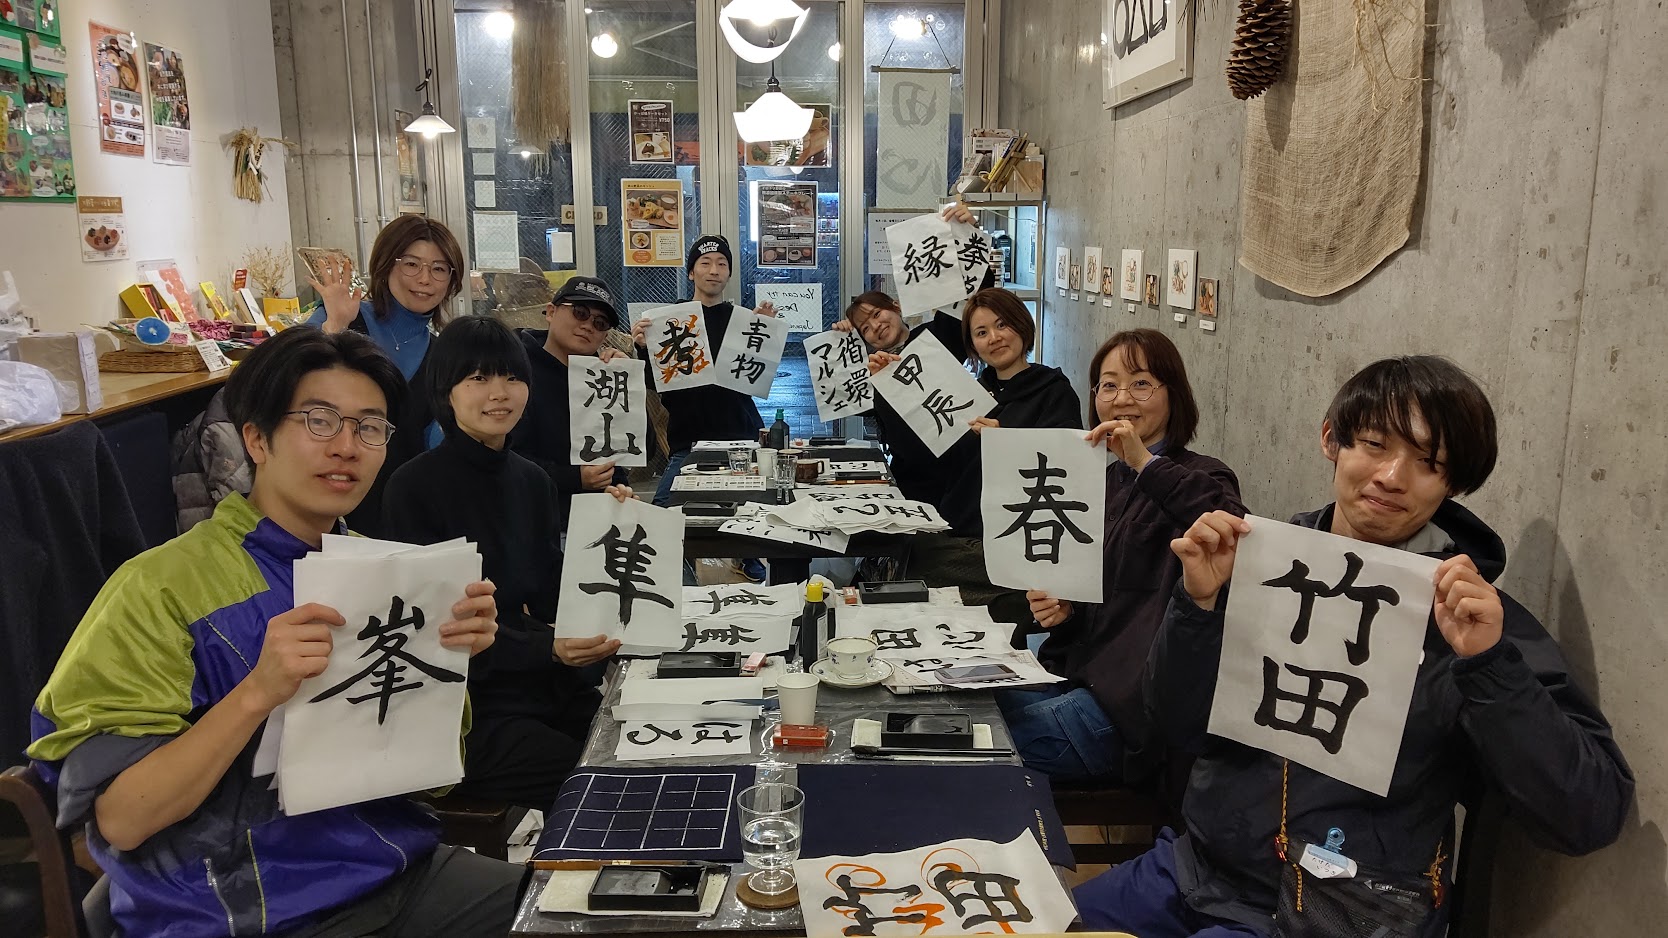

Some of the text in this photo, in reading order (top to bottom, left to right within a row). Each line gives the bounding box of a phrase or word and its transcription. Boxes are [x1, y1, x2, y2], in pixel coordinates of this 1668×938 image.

[904, 236, 954, 286] 縁
[729, 317, 770, 385] 青物
[810, 342, 848, 412] マルシェ
[837, 334, 872, 408] 循環
[891, 353, 975, 437] 甲辰
[579, 368, 642, 462] 湖山
[997, 453, 1092, 563] 春
[578, 523, 675, 626] 隼
[309, 597, 466, 726] 峯
[1254, 551, 1400, 756] 竹田
